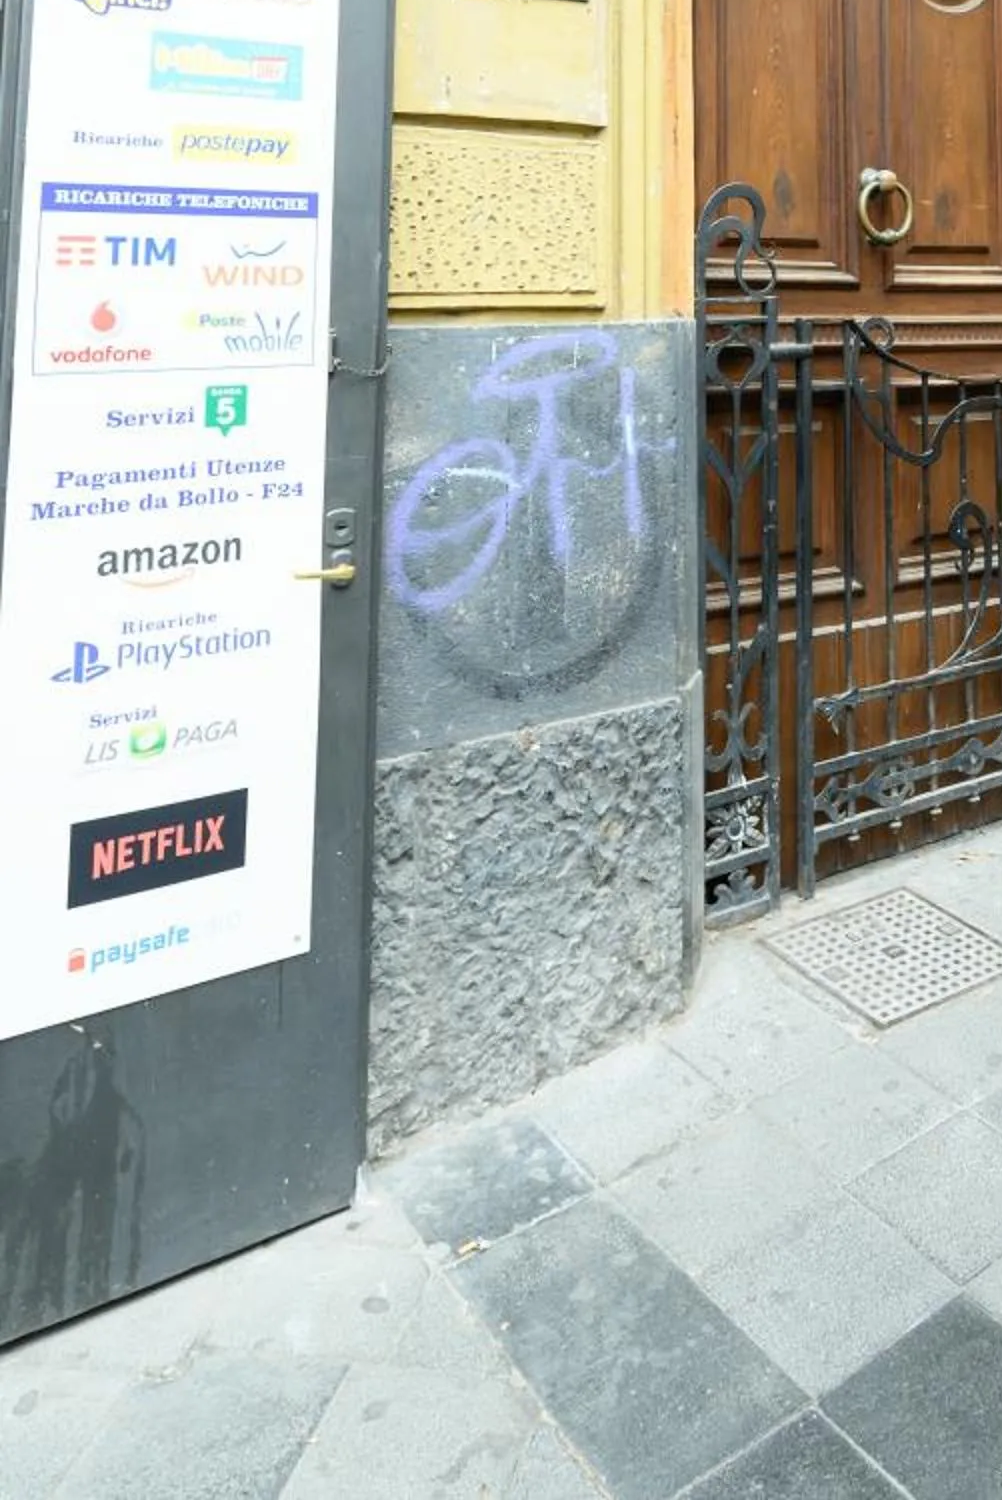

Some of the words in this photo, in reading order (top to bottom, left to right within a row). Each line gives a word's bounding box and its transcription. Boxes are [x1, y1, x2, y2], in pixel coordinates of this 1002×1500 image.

[72, 130, 164, 150] Ricariche
[180, 132, 290, 159] postepay
[55, 188, 171, 209] RICARICHE
[176, 192, 309, 212] TELEFONICHE
[104, 236, 177, 267] TIM
[202, 264, 304, 287] WIND
[198, 312, 247, 330] Poste
[224, 311, 304, 352] mobile
[50, 345, 152, 366] vodafone
[105, 405, 196, 429] Servizi
[216, 396, 236, 426] 5
[55, 461, 197, 491] Pagamenti
[206, 457, 286, 478] Utenze
[30, 497, 130, 522] Marche
[139, 493, 168, 512] da
[178, 488, 239, 508] Bollo
[262, 482, 304, 500] F24
[97, 536, 242, 578] amazon
[121, 611, 218, 635] Ricariche
[117, 625, 271, 670] PlayStation
[89, 705, 158, 730] Servizi
[84, 740, 119, 766] LIS
[172, 719, 239, 750] PAGA
[91, 815, 225, 881] NETFLIX
